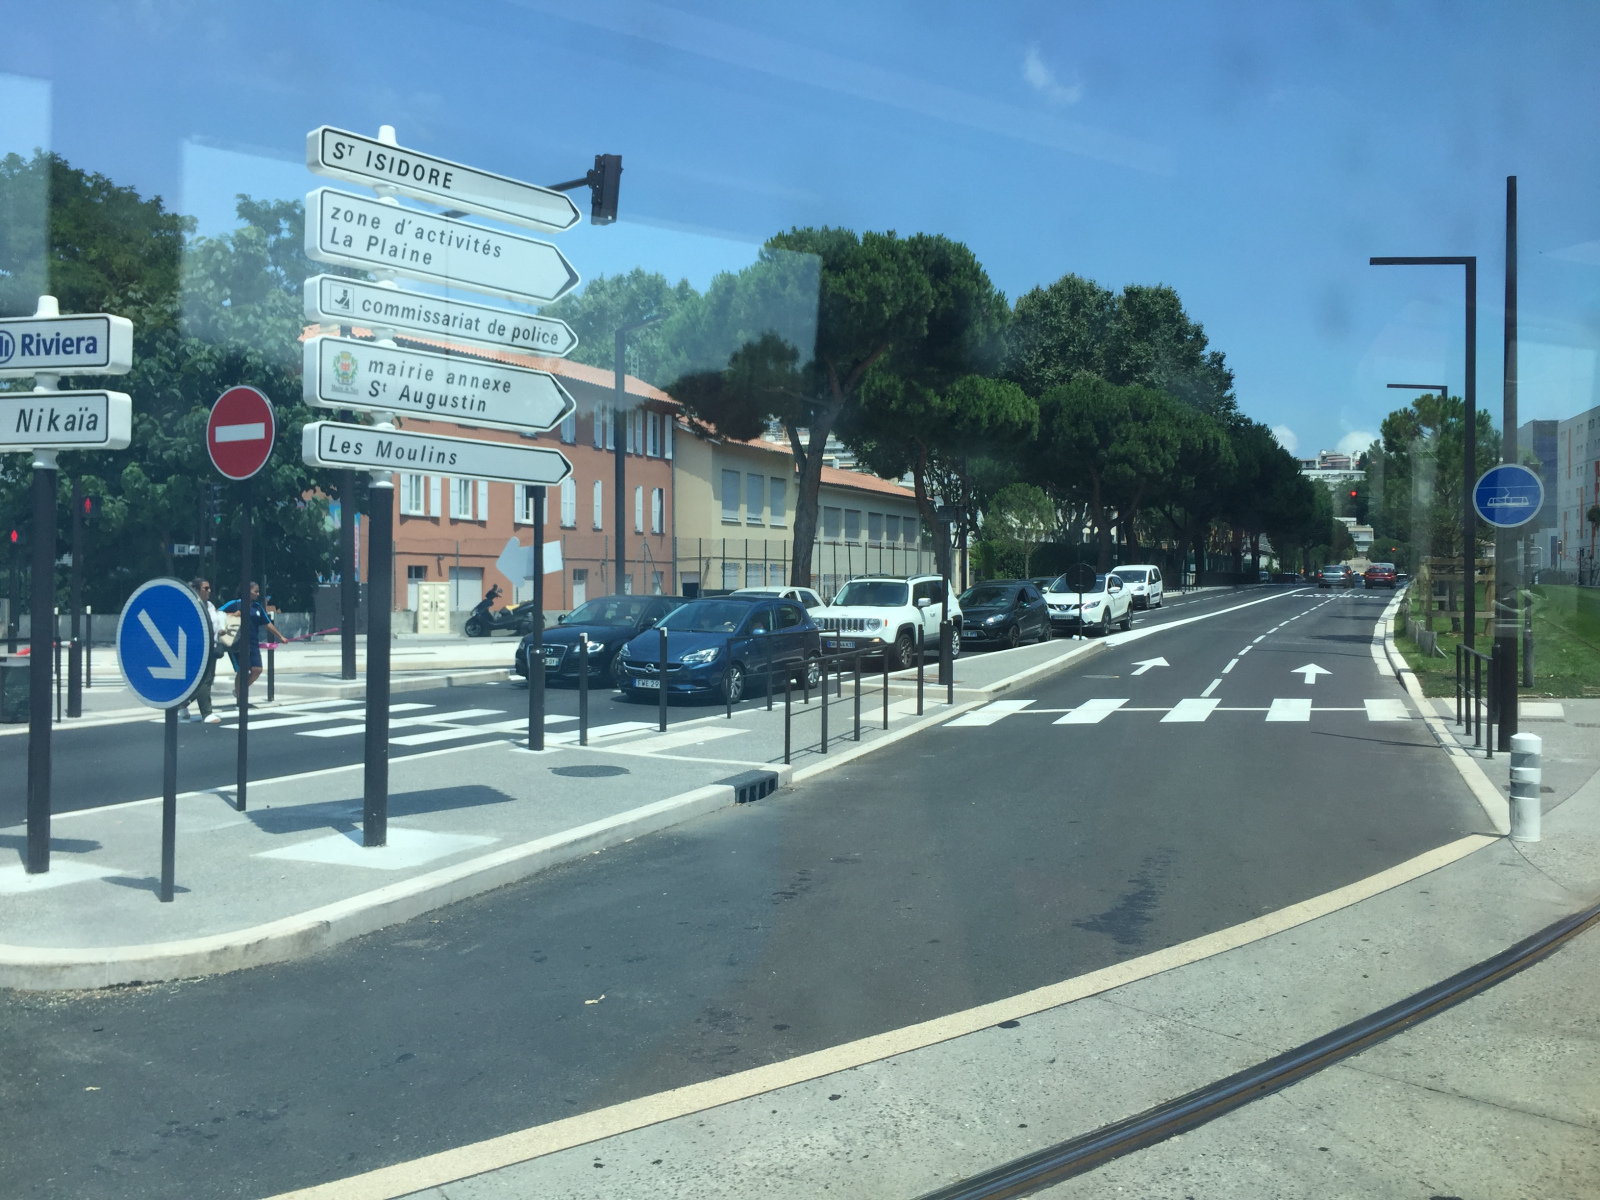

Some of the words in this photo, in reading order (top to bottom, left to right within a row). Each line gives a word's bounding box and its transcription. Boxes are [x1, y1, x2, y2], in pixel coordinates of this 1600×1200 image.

[366, 150, 454, 189] ISIDORE
[330, 206, 381, 230] zone
[394, 218, 502, 258] d'activités
[330, 226, 353, 248] La
[366, 238, 433, 265] Plaine
[361, 298, 481, 332] commissariat
[487, 319, 506, 336] de
[511, 322, 559, 346] police
[20, 332, 98, 357] Riviera
[368, 358, 435, 382] mairie
[446, 369, 512, 393] annexe
[368, 380, 387, 398] St
[398, 384, 487, 413] Augustin
[15, 407, 99, 433] Nikaïa
[328, 434, 363, 455] Les
[375, 440, 458, 465] Moulins
